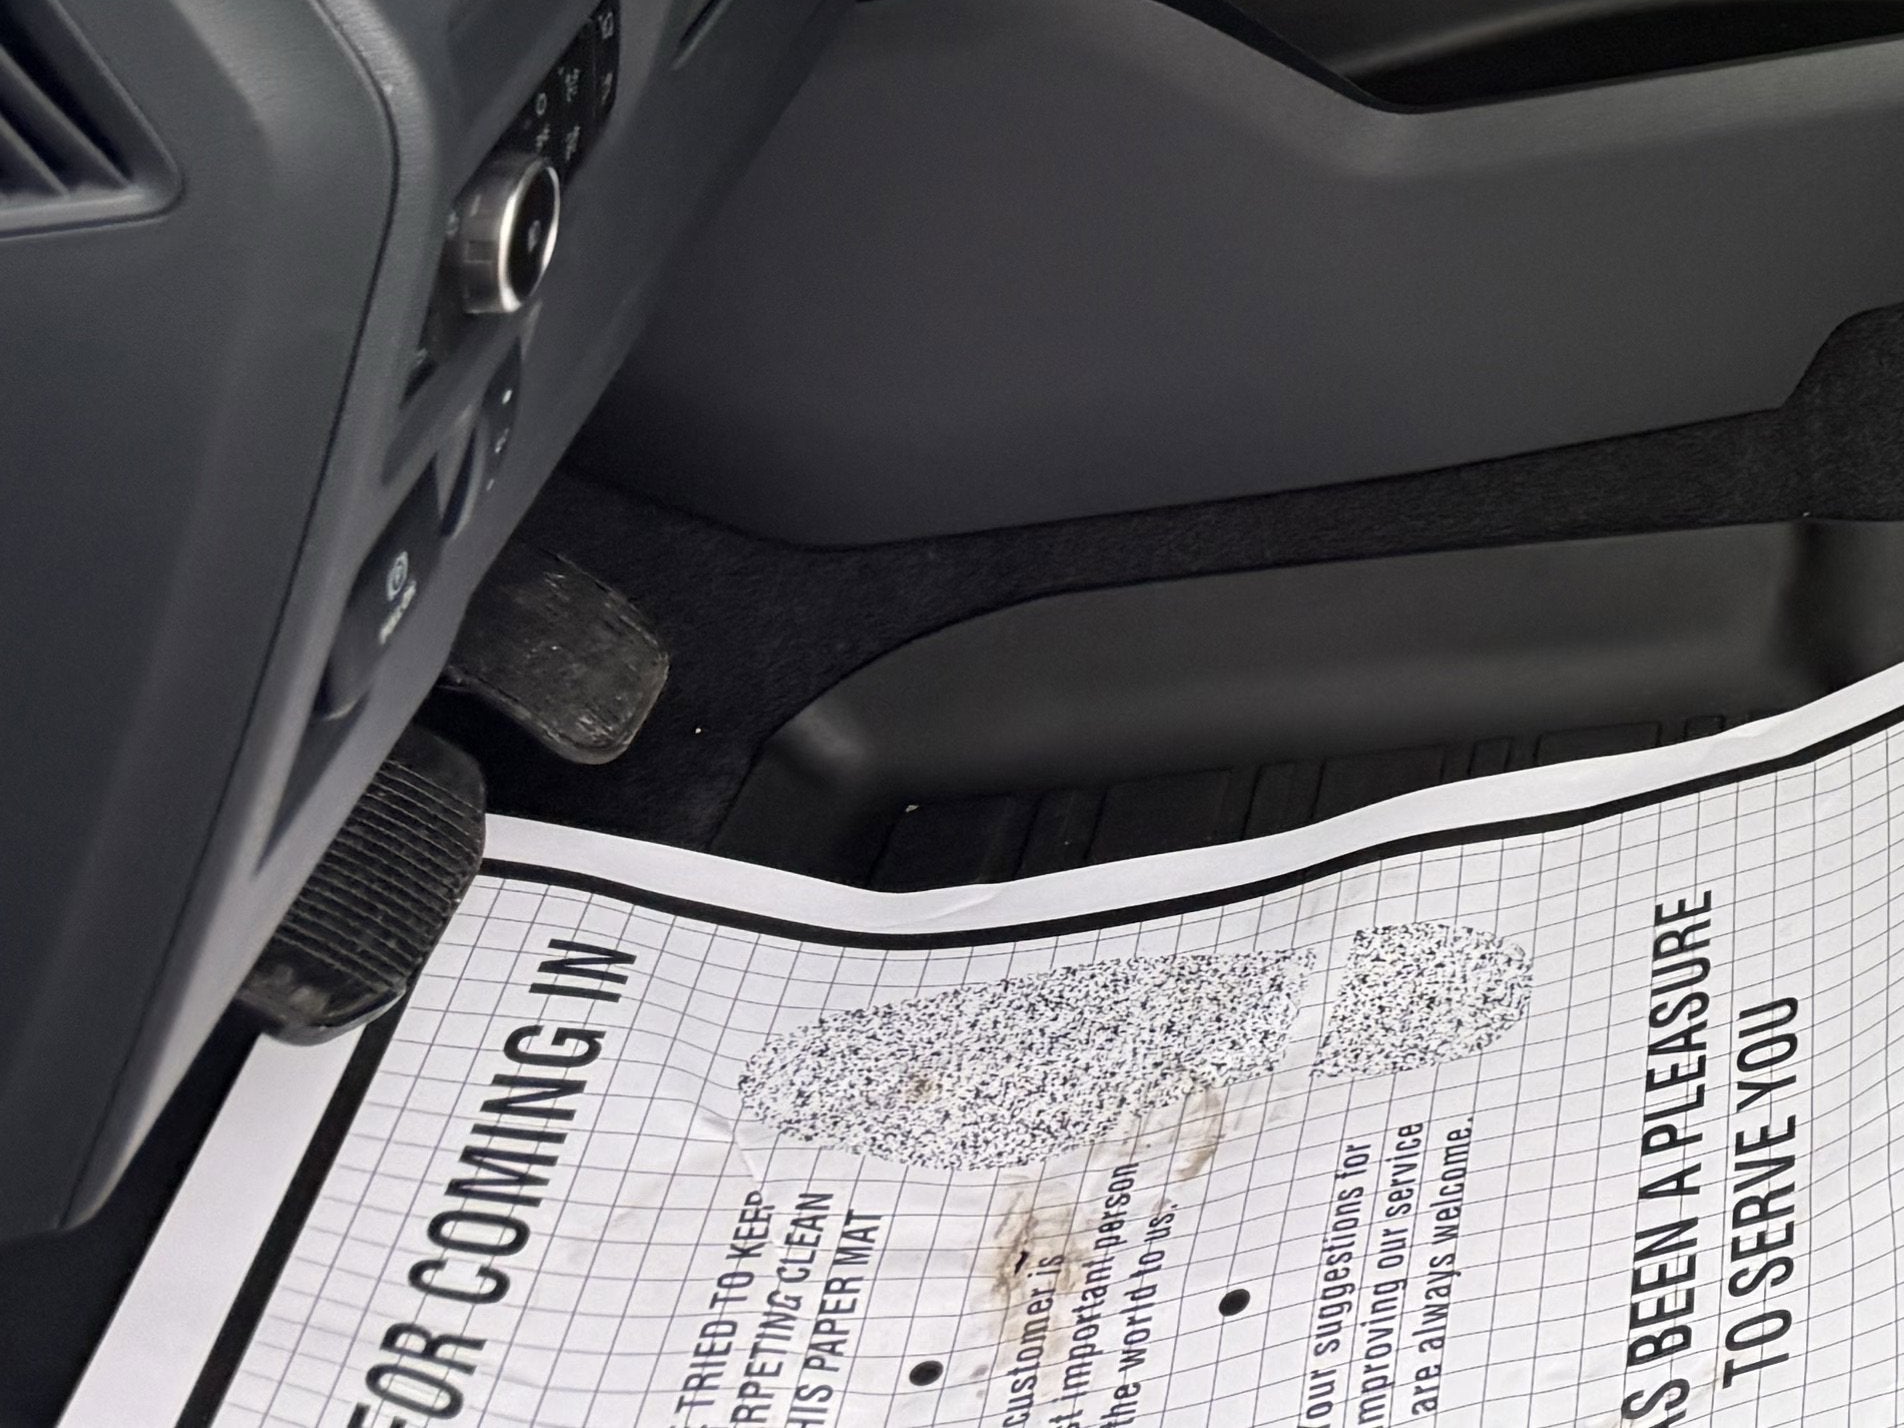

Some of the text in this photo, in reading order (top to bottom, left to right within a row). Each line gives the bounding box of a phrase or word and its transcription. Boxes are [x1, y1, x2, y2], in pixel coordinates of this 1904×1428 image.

[407, 1024, 608, 1305] COMING
[528, 938, 638, 1003] IN
[1640, 890, 1712, 1158] PLEASURE
[1053, 1256, 1115, 1402] important
[1093, 1162, 1140, 1250] person
[1129, 1249, 1165, 1279] to
[1296, 1143, 1371, 1428] our suggestions for
[1357, 1122, 1423, 1428] mproving our service
[1411, 1116, 1474, 1416] are always welcome.
[1625, 1215, 1700, 1367] BEEN
[1637, 1163, 1702, 1201] A
[1722, 996, 1799, 1389] TO SERVE YOU
[674, 1190, 776, 1414] TRIED TO KEEP
[729, 1192, 834, 1425] RPETING CLEAN
[784, 1209, 883, 1428] HIS PAPER MAT
[1002, 1254, 1066, 1428] customer is
[1099, 1381, 1142, 1428] the
[1118, 1283, 1158, 1373] world
